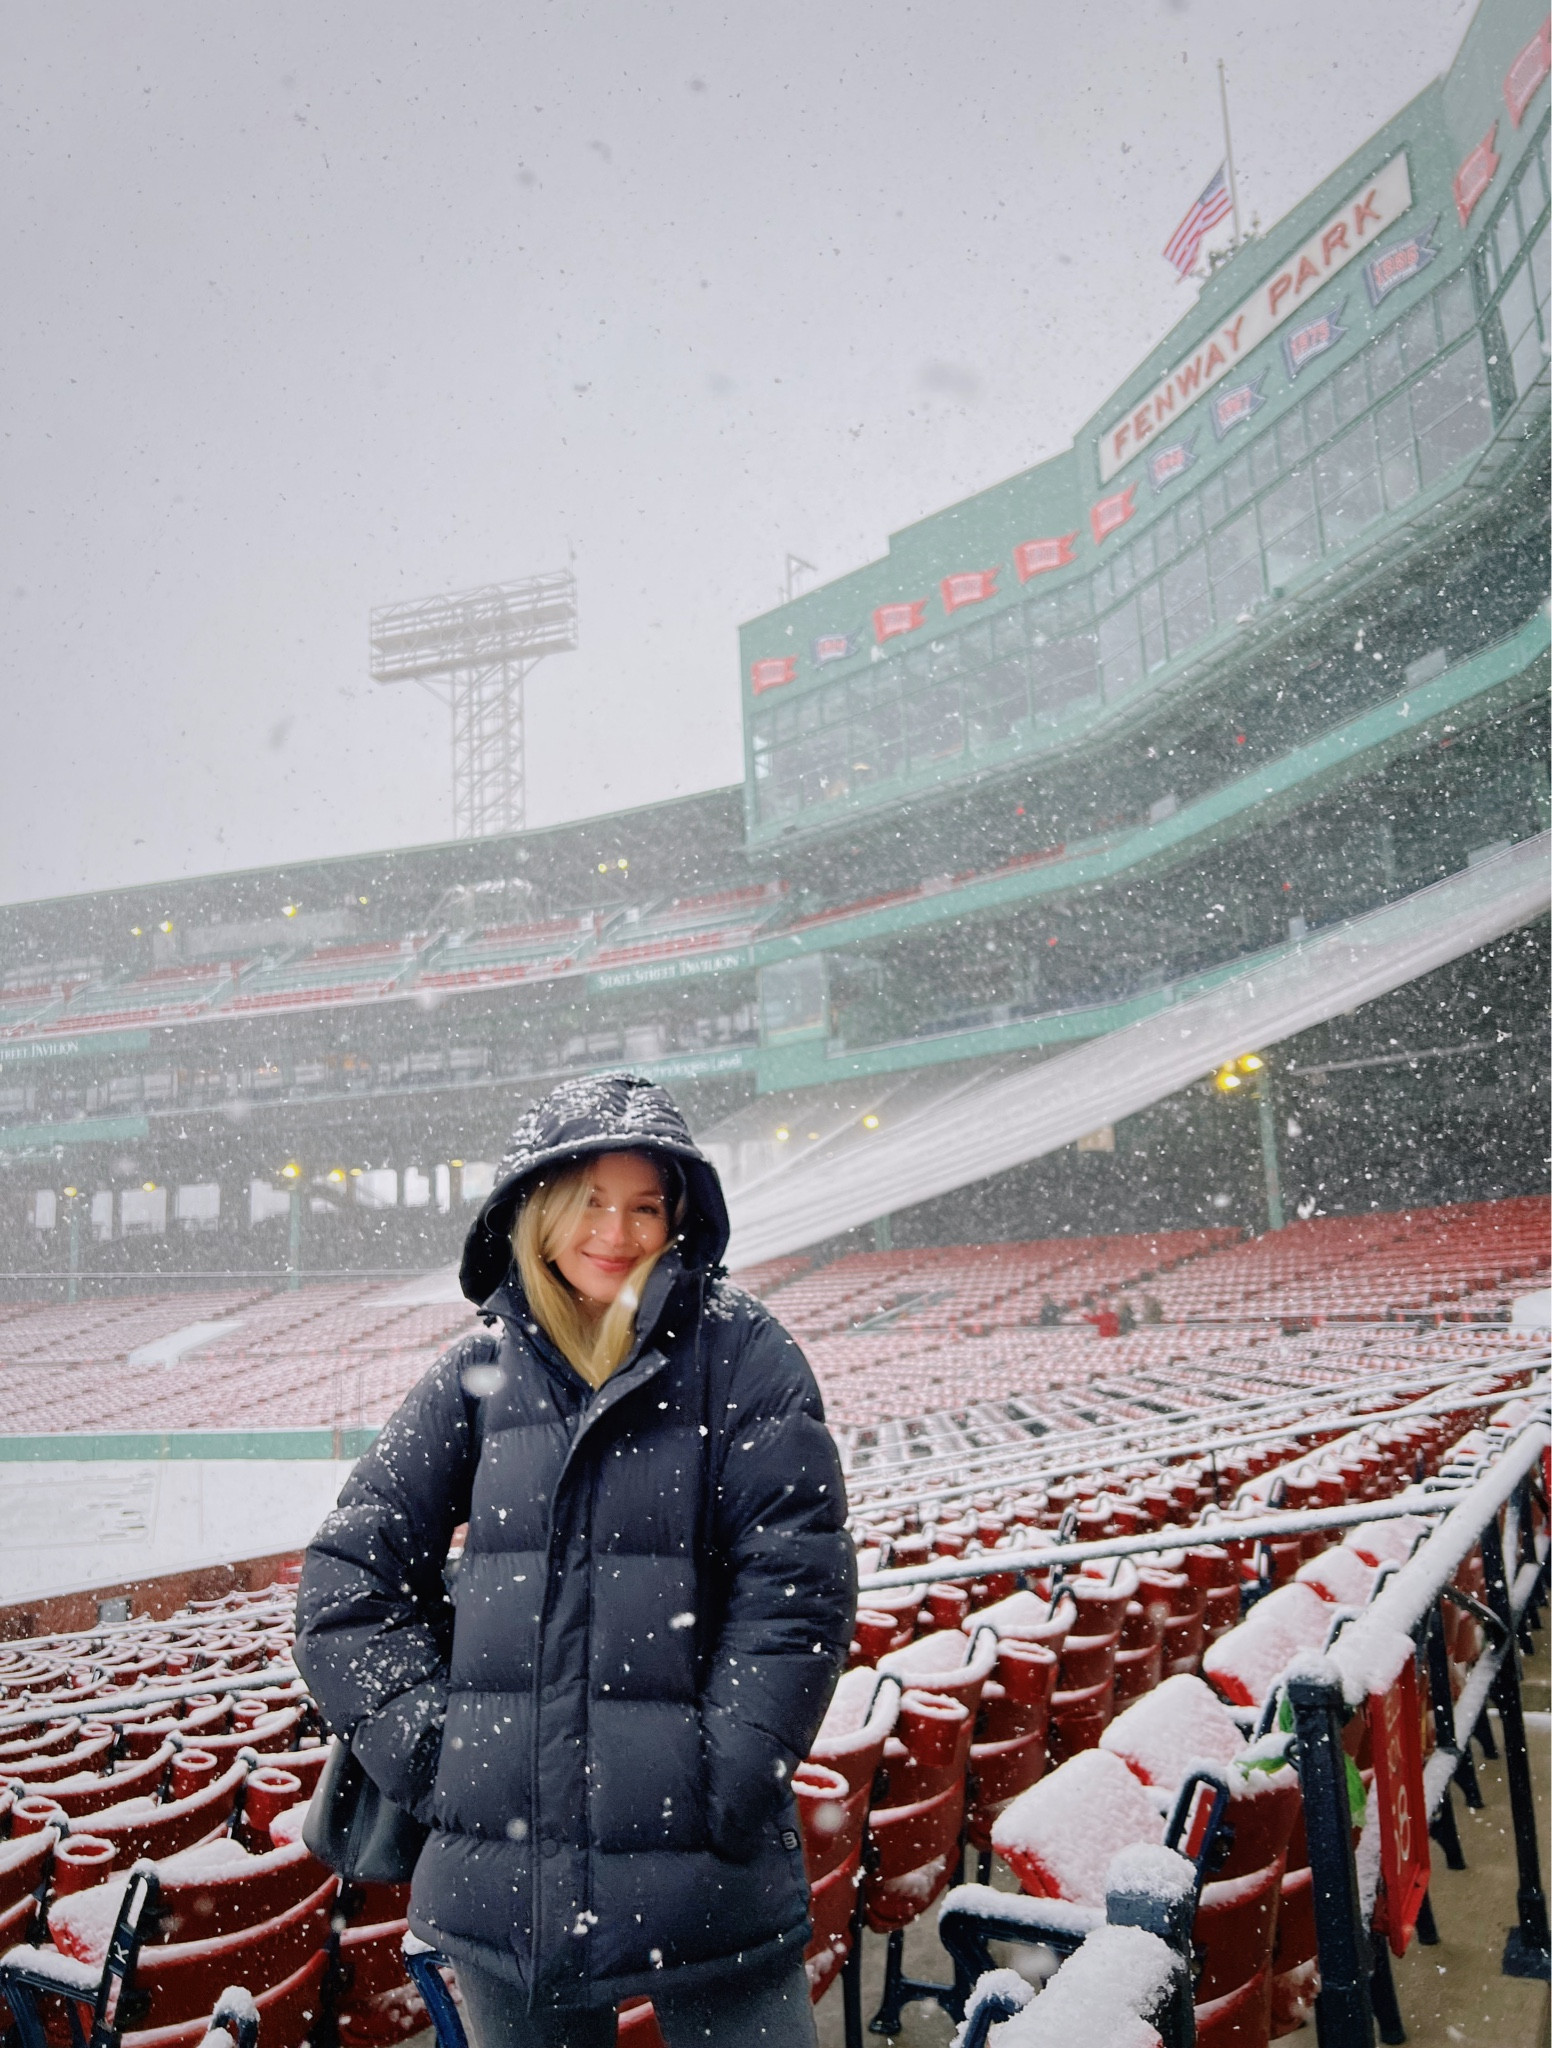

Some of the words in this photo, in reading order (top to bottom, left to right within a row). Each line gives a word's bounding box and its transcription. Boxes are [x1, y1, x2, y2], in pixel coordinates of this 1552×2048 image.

[1112, 314, 1244, 461] FENWAY
[1267, 188, 1382, 317] PARK
[599, 974, 631, 989] STATE
[634, 965, 676, 982] STREET
[679, 954, 739, 975] PAVILION
[31, 1041, 79, 1057] PAVILION
